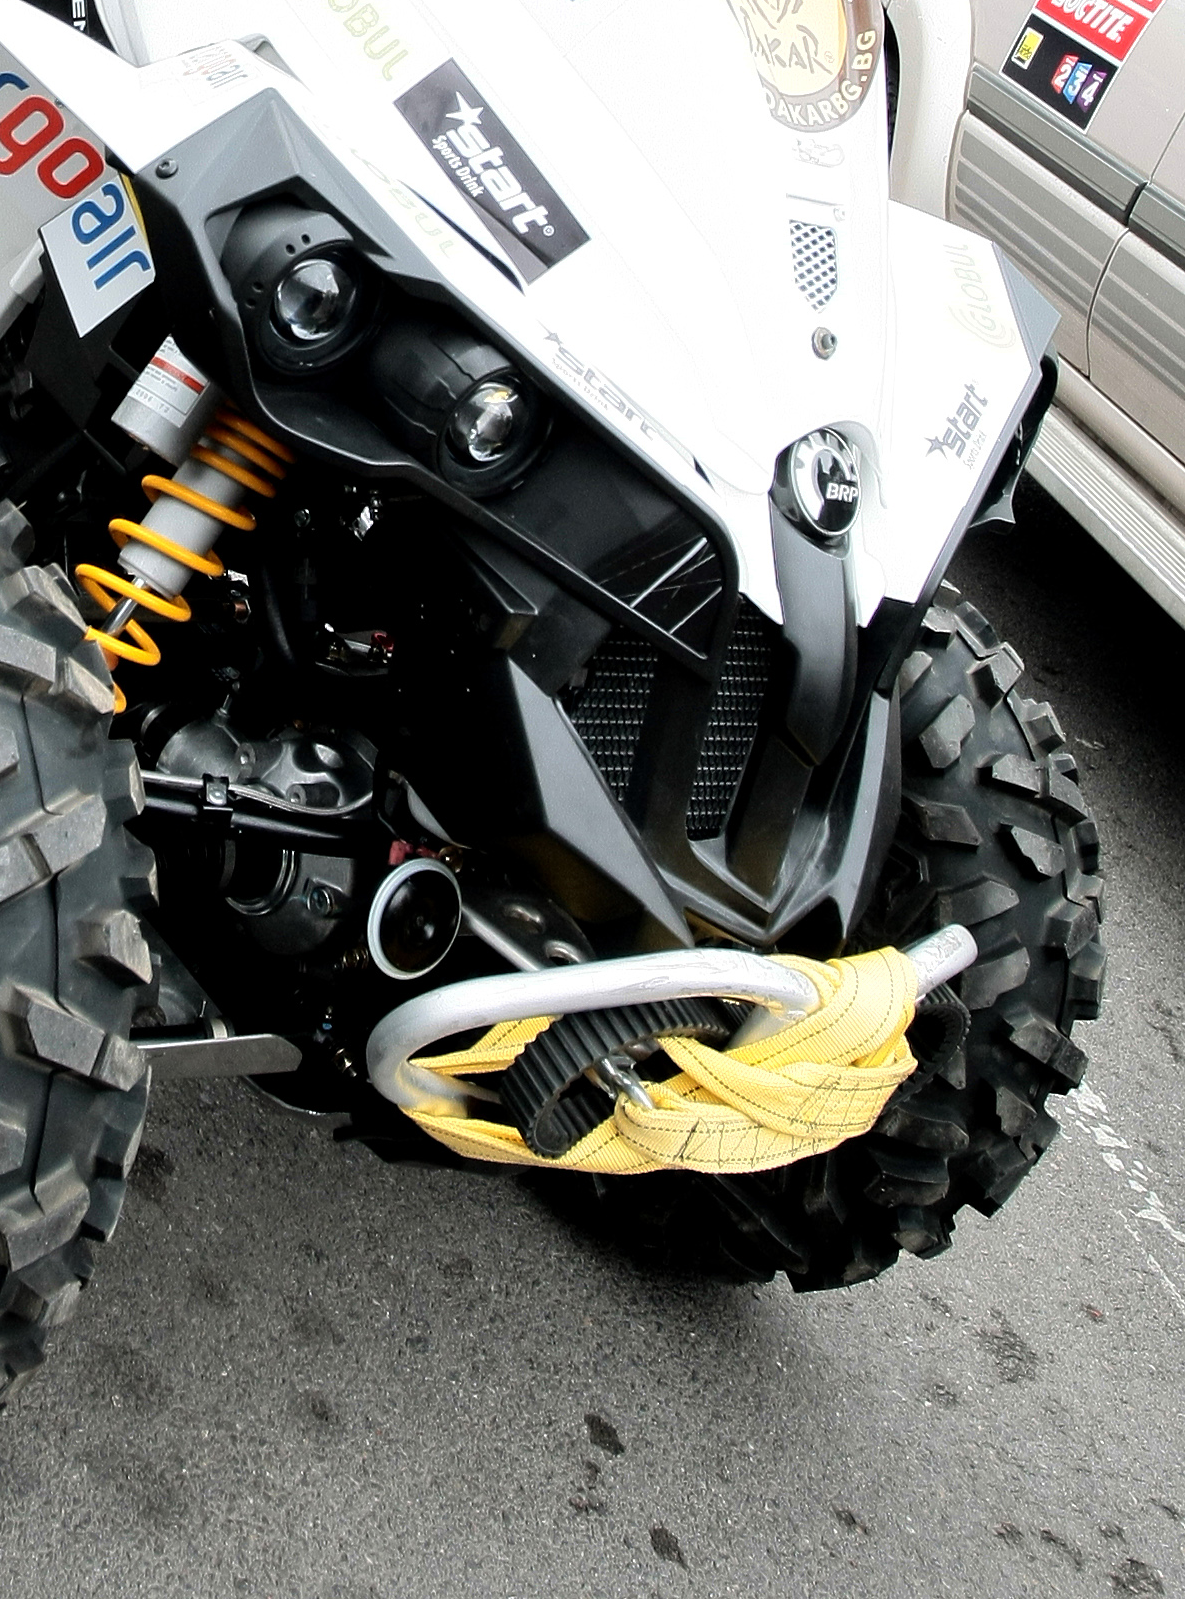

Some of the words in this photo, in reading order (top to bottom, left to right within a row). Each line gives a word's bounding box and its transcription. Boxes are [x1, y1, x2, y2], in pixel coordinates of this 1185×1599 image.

[432, 134, 463, 170] Sports
[455, 166, 485, 198] Drink
[446, 124, 550, 235] start
[555, 346, 658, 442] start
[942, 383, 989, 460] start
[826, 482, 860, 504] BRP
